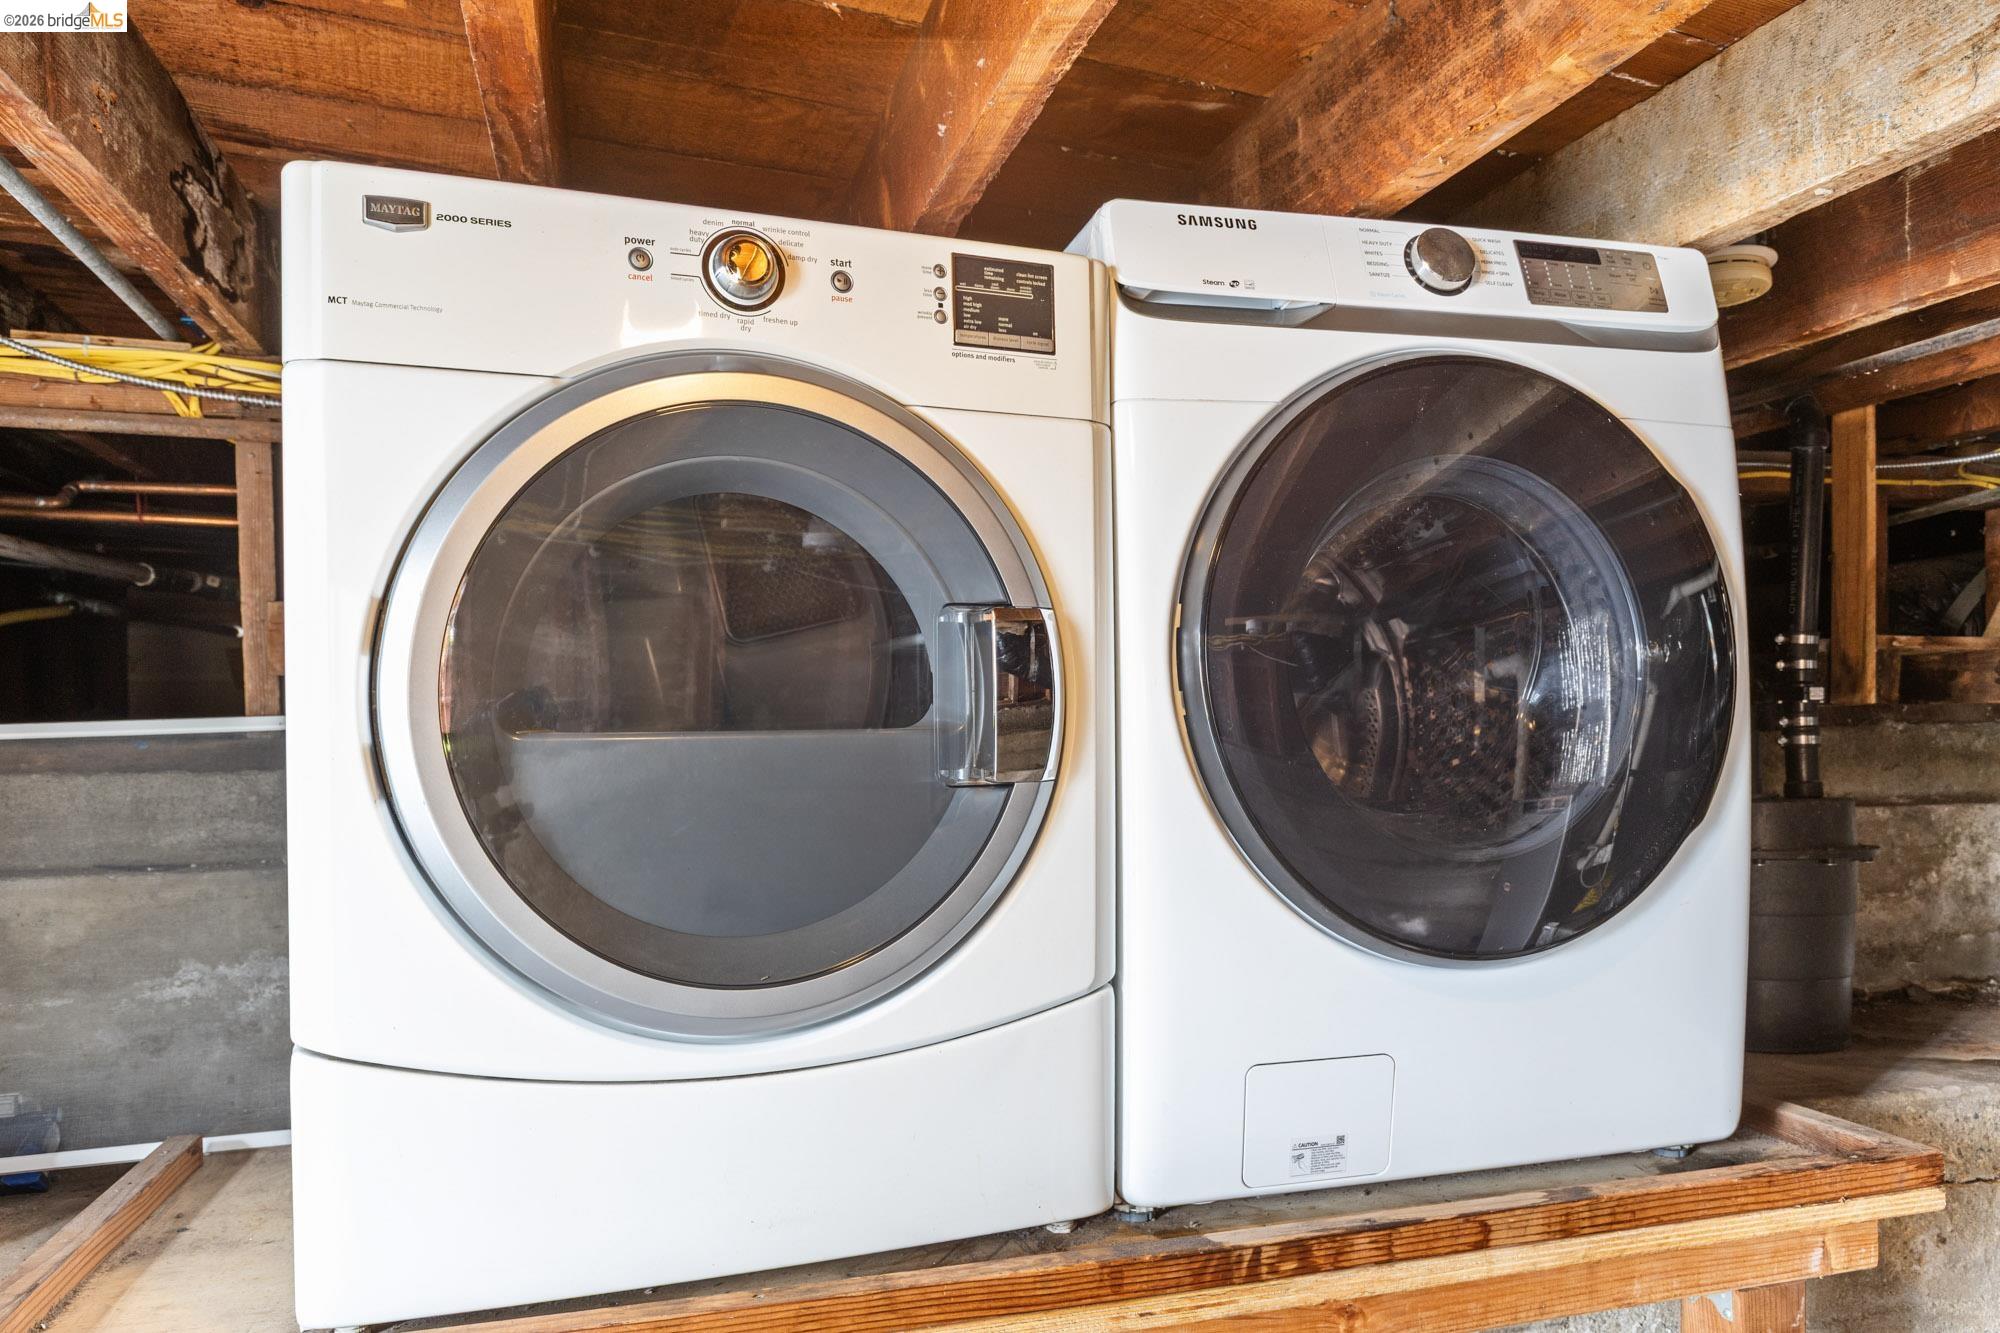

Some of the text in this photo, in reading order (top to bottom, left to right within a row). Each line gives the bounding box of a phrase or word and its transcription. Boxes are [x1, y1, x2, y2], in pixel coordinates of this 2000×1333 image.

[370, 202, 421, 217] MAYTAG
[436, 213, 512, 228] 2000 SERIES
[702, 219, 724, 227] denim
[731, 219, 755, 227] normal
[1177, 214, 1257, 230] SAMSUNG
[689, 228, 710, 237] heavy
[762, 226, 811, 237] wrinkle control
[624, 236, 656, 246] power
[689, 236, 705, 244] duty
[778, 240, 804, 248] delicate
[787, 254, 818, 264] damp dry
[830, 259, 852, 268] start
[628, 273, 653, 282] cancel
[328, 296, 348, 305] MCT
[831, 295, 853, 303] pause
[352, 300, 443, 314] Maytag Commercial Technology
[719, 312, 731, 320] dry
[763, 316, 788, 325] freshen
[737, 318, 755, 327] rapid
[740, 325, 752, 333] dry
[988, 355, 1016, 363] modifiers
